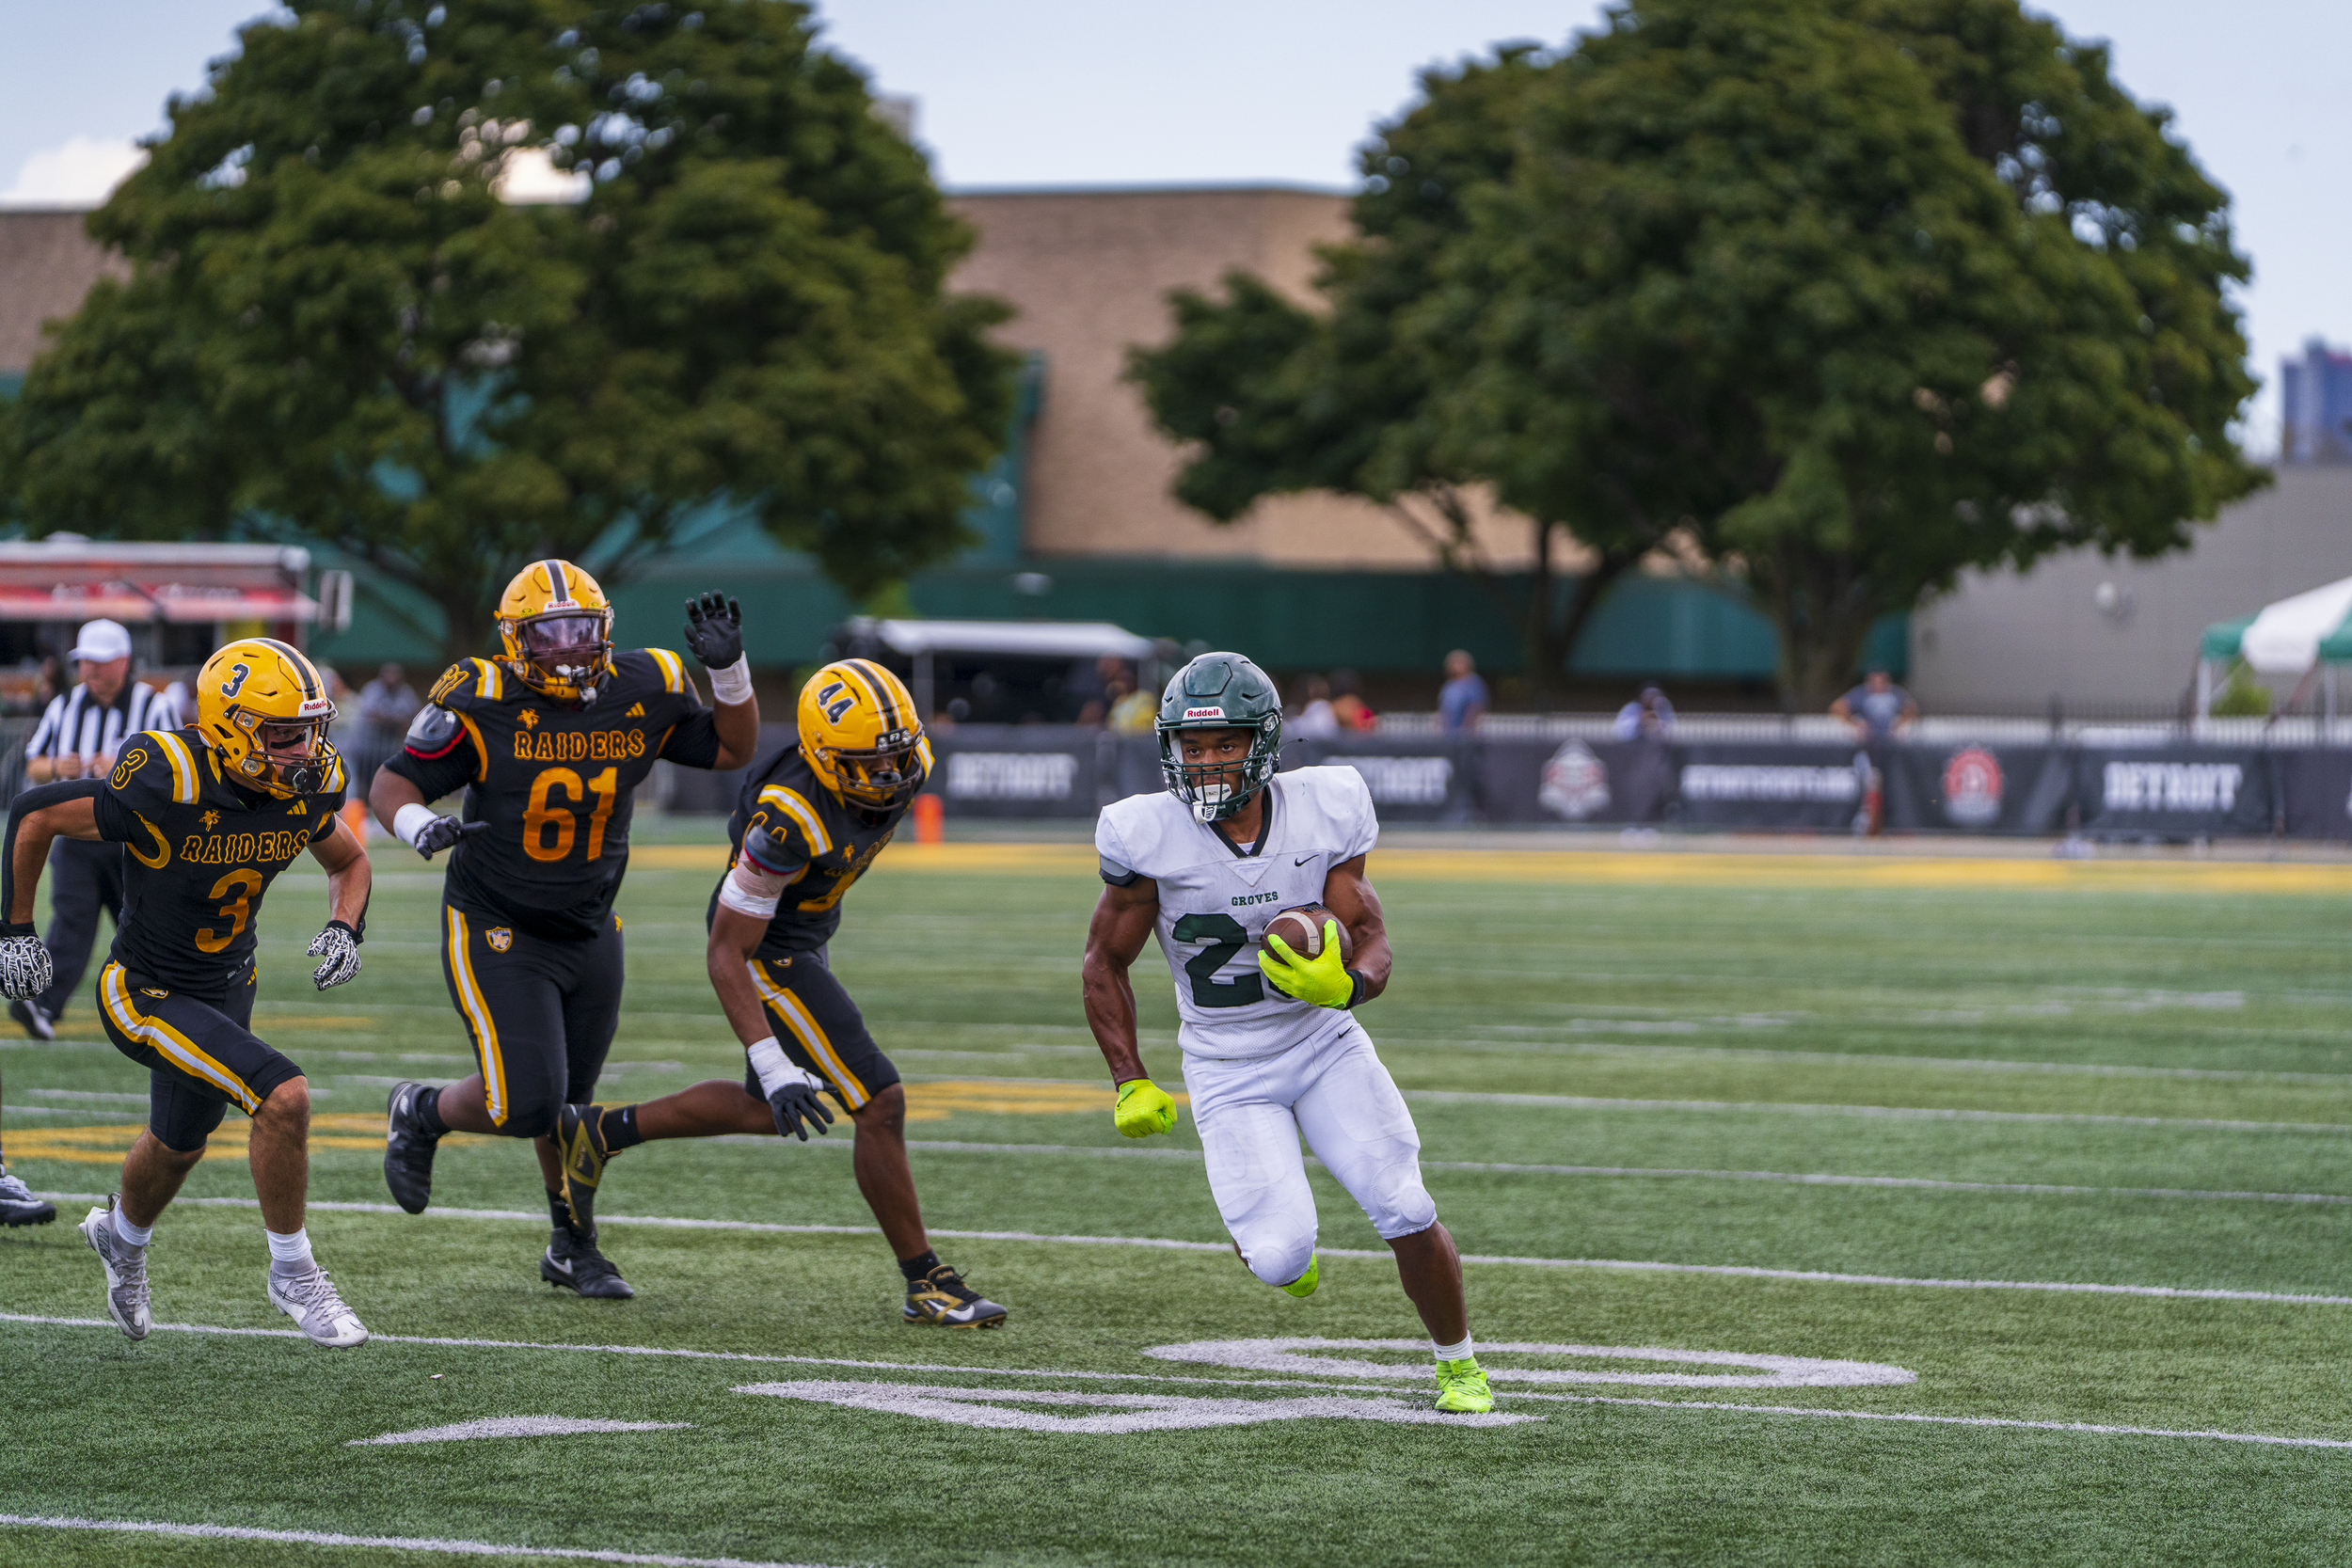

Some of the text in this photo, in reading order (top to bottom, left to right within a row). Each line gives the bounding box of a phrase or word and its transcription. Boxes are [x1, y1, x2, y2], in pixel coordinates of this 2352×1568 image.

[220, 662, 250, 700] 3
[816, 680, 856, 726] 44
[1187, 708, 1219, 718] Riddell
[514, 728, 646, 761] RAIDERS
[110, 748, 149, 790] 3
[522, 767, 618, 863] 61
[180, 829, 310, 864] RAIDERS
[195, 868, 263, 953] 3
[1231, 891, 1279, 907] GROVES
[1172, 901, 1323, 1007] 2
